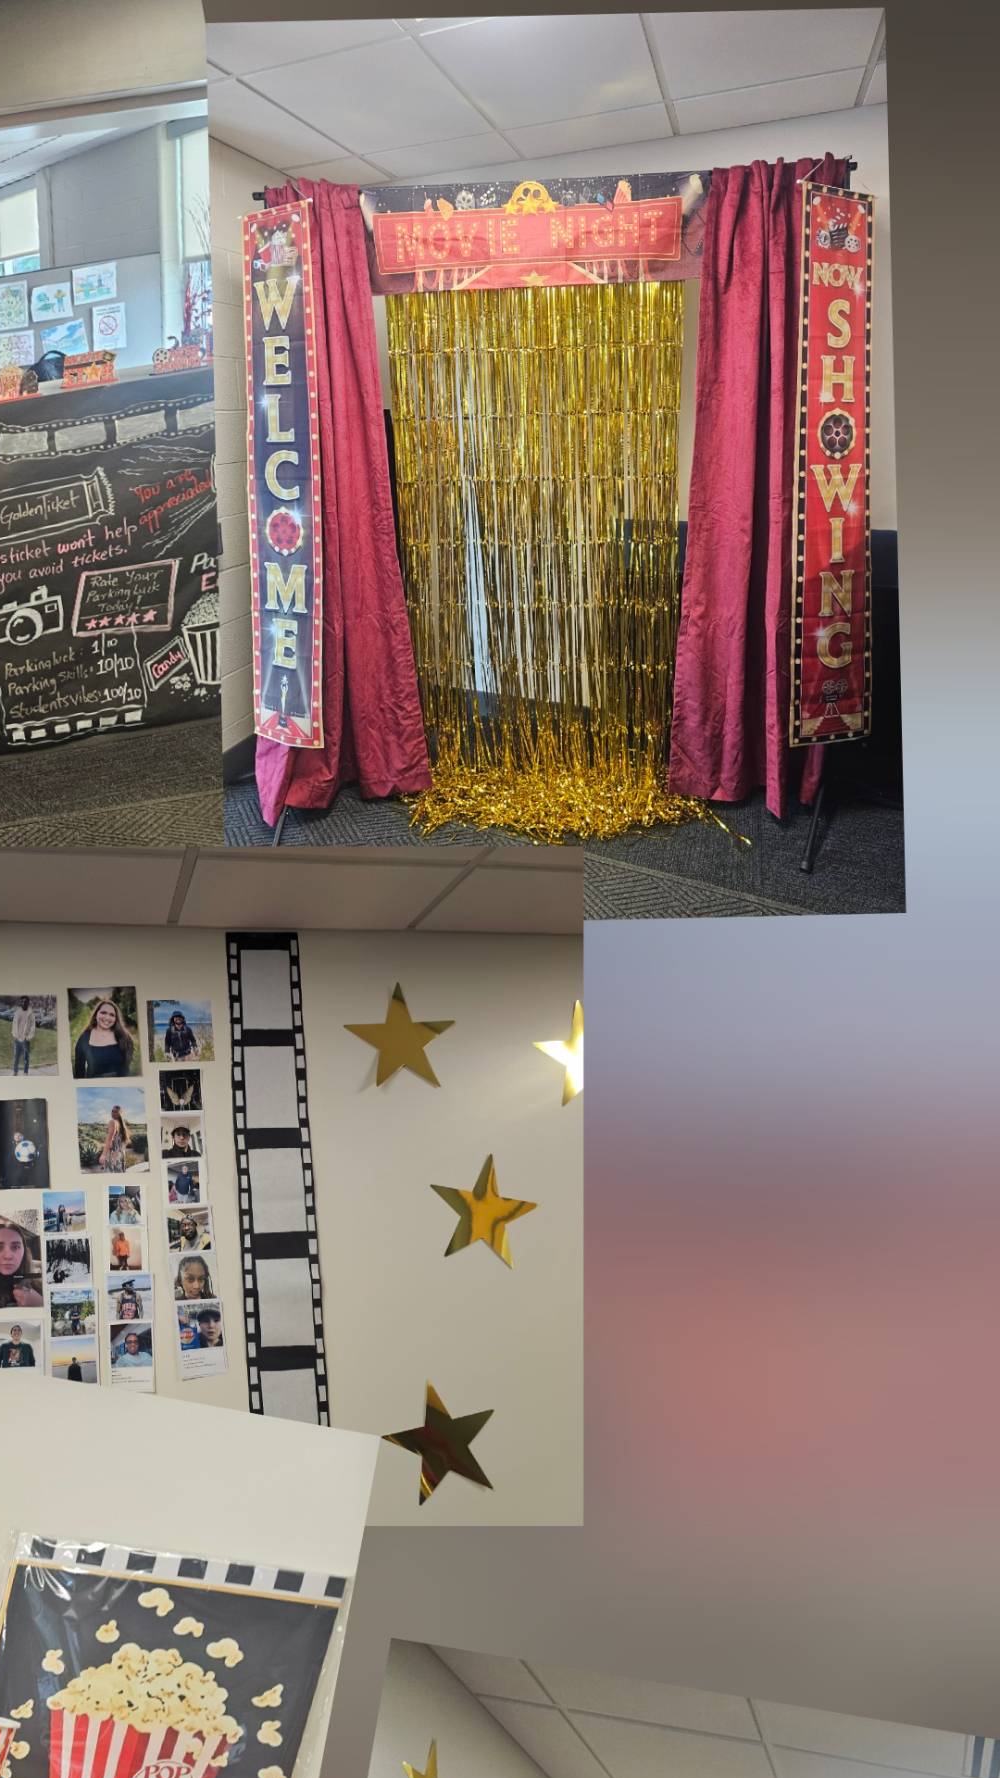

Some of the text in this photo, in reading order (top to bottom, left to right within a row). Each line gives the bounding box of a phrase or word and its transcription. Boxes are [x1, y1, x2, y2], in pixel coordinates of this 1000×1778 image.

[397, 208, 663, 262] MOVIE NIGHT
[812, 260, 864, 288] NOW
[104, 516, 139, 546] help
[28, 559, 64, 580] avoid
[89, 568, 163, 590] Rate Your
[150, 647, 186, 680] Candy
[7, 676, 58, 697] Parking
